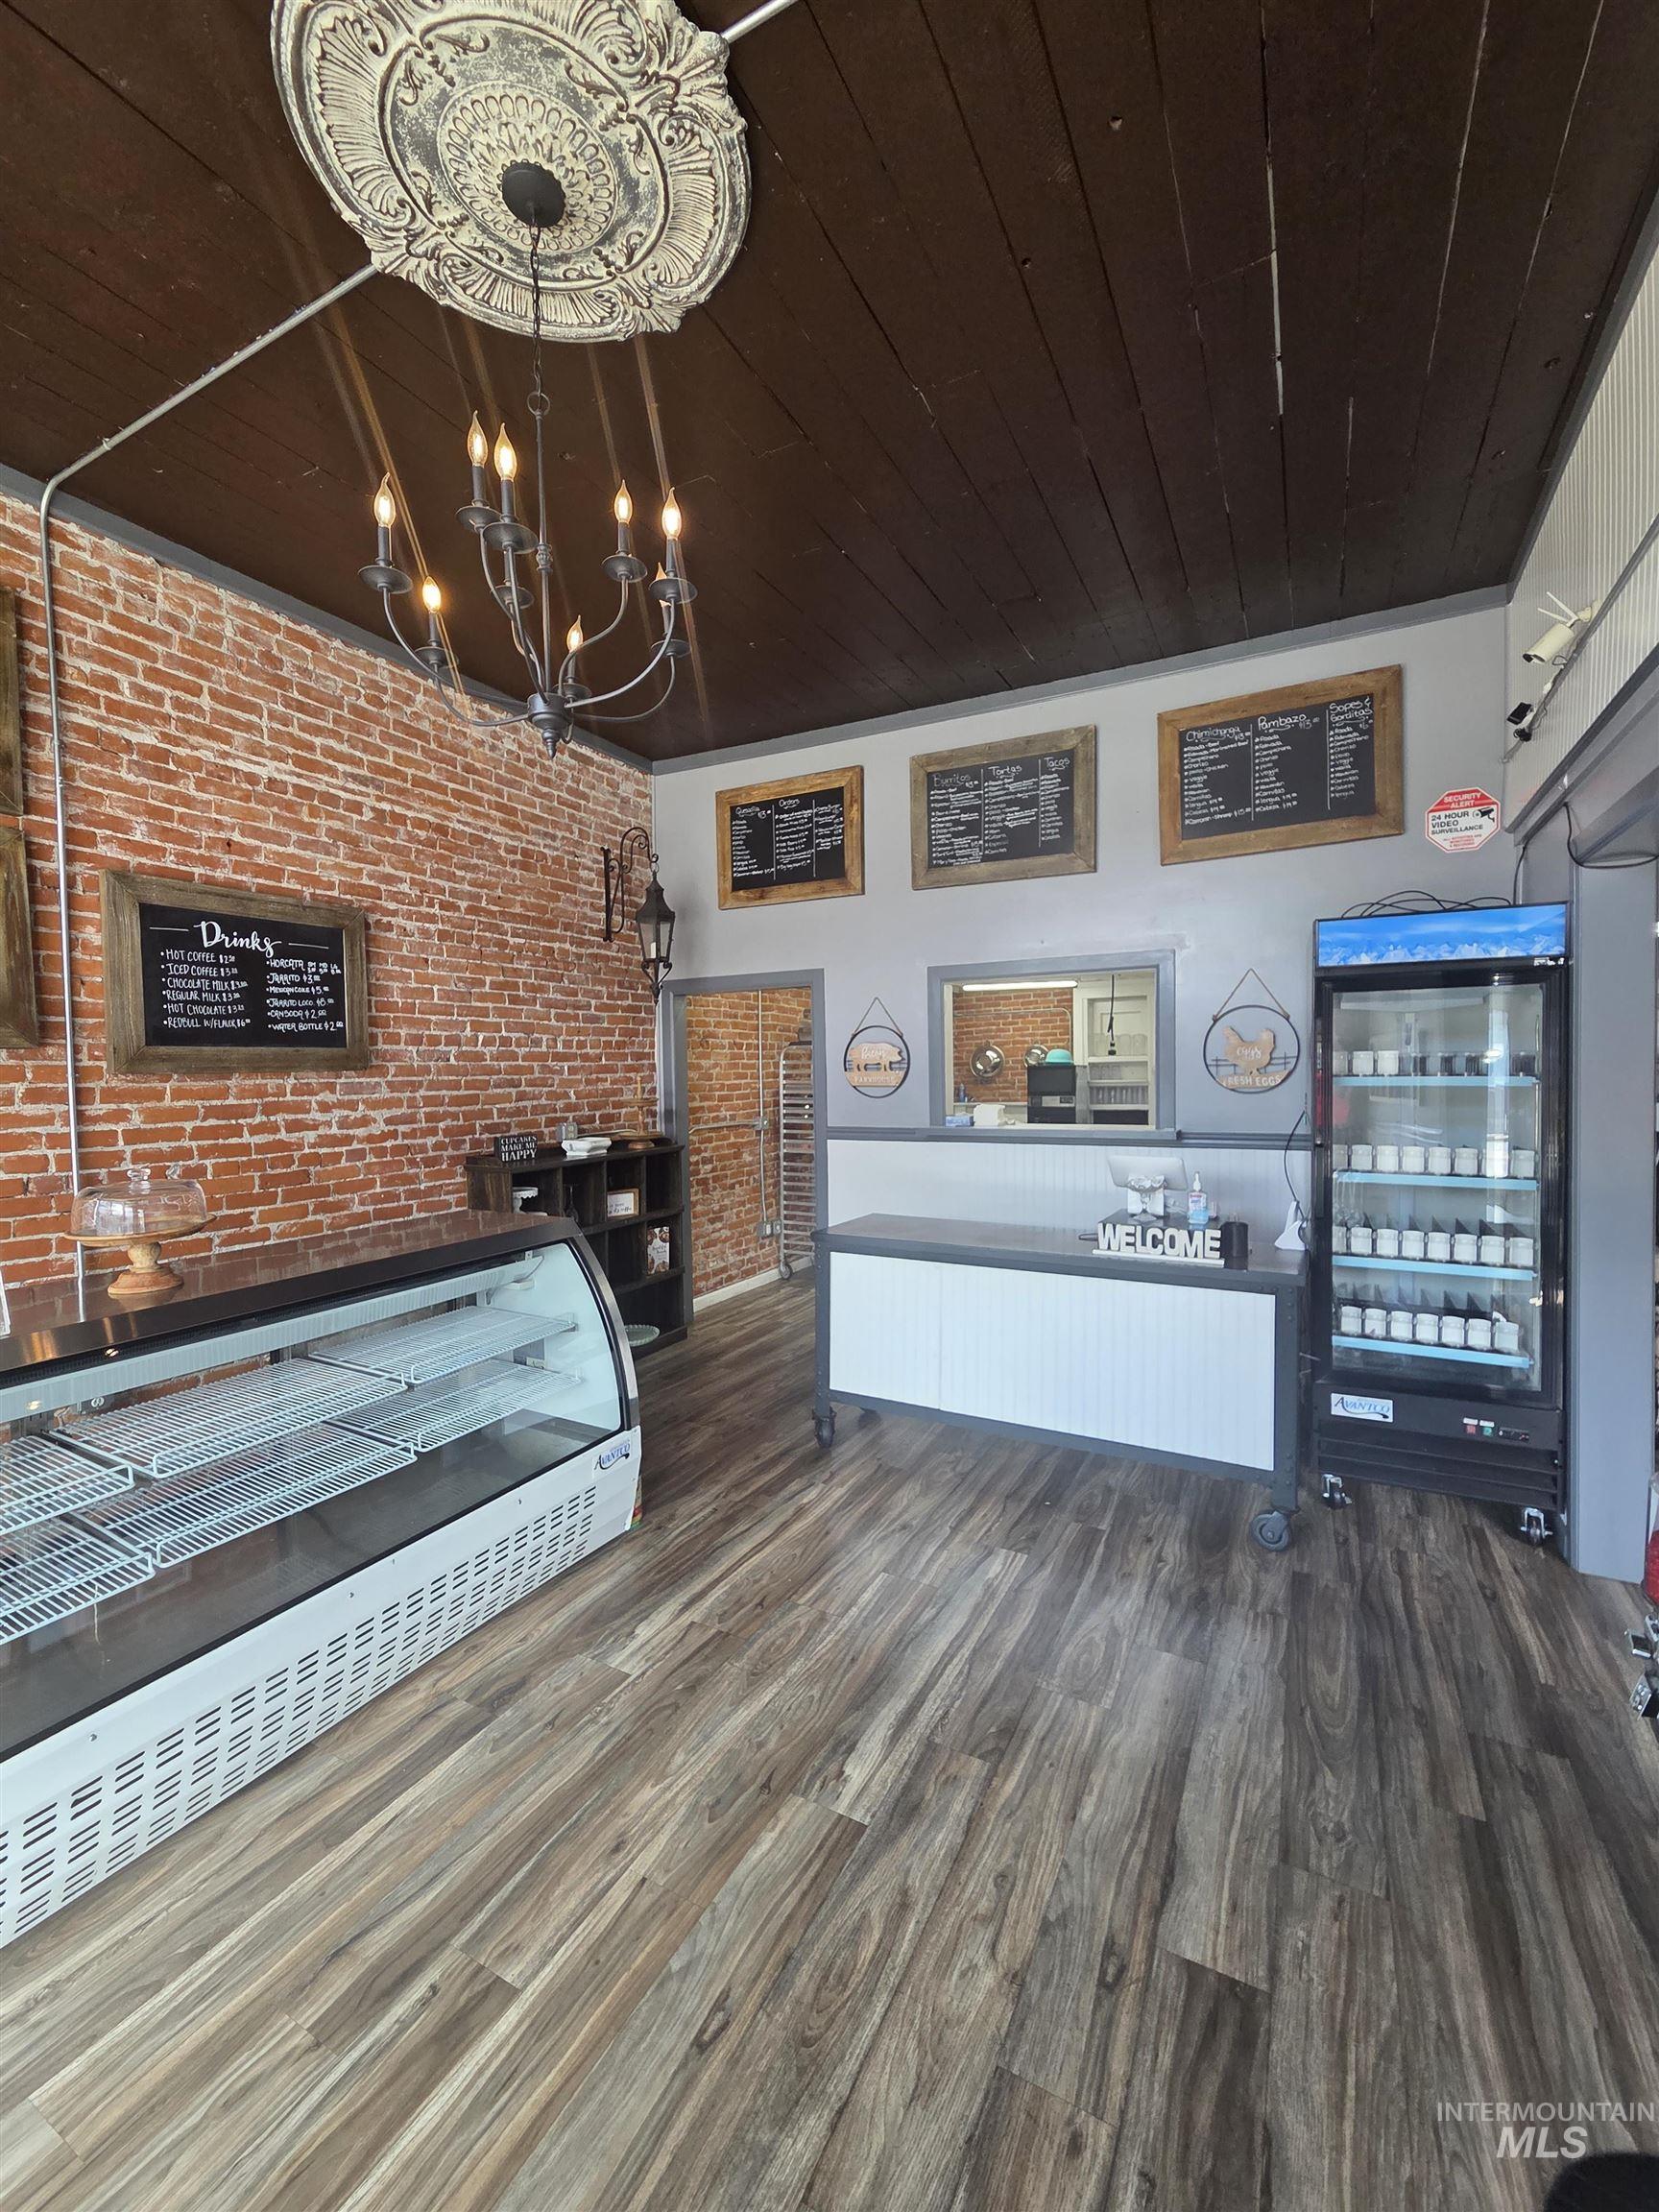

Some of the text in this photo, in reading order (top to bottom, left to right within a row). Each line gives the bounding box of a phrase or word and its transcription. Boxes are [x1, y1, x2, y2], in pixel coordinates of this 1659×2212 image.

[1330, 701, 1363, 713] Sopes
[1330, 708, 1373, 722] Gorditas
[1258, 713, 1307, 731] Pambazo
[1044, 757, 1070, 768] Tacos
[988, 765, 1022, 776] Tortas
[932, 773, 971, 786] Burritos
[1444, 792, 1482, 803] SECURITY
[1451, 800, 1476, 809] ALERT
[1444, 811, 1469, 820] HOUR
[1431, 825, 1483, 835] SURVEILLANCE
[193, 921, 282, 958] Drinks
[166, 949, 184, 960] HOT
[187, 951, 217, 963] COFFEE
[166, 963, 190, 974] ICED
[190, 965, 219, 976] COFFEE
[167, 977, 211, 991] CHOCOLATE
[212, 980, 230, 991] MILK
[166, 990, 201, 1001] REGULAR
[202, 992, 221, 1002] MILK
[167, 1003, 183, 1014] HOT
[187, 1004, 226, 1015] CHOCOLATE
[167, 1017, 202, 1028] REDBULL
[272, 1022, 298, 1033] WATER
[1255, 1075, 1280, 1085] EGGS
[501, 1136, 537, 1144] CUPCAKES
[501, 1142, 524, 1151] MAKE
[501, 1149, 537, 1162] HAPPY
[1097, 1222, 1222, 1260] WELCOME
